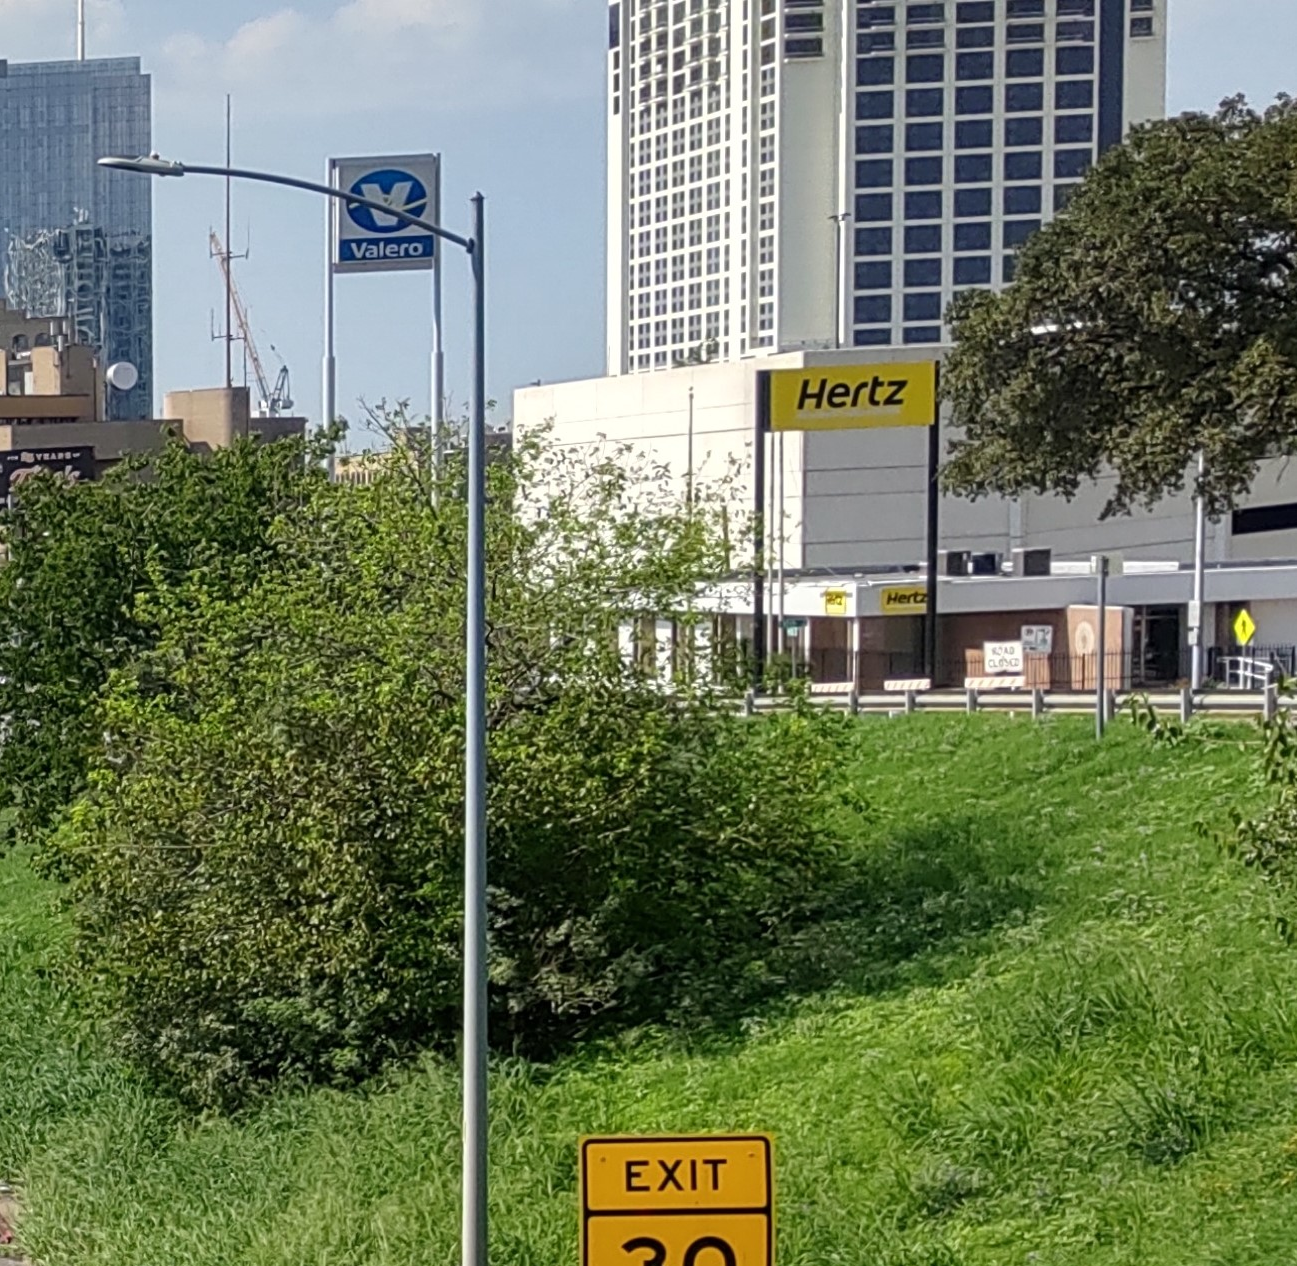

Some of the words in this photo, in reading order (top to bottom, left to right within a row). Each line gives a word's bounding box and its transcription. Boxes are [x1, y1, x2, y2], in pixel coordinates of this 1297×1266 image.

[350, 241, 424, 259] Valero
[797, 376, 908, 410] Hertz
[35, 451, 72, 460] YEARS
[886, 591, 928, 605] Hertz
[991, 646, 1015, 656] ROAD
[987, 658, 1020, 668] CLOSED
[625, 1159, 727, 1192] EXIT
